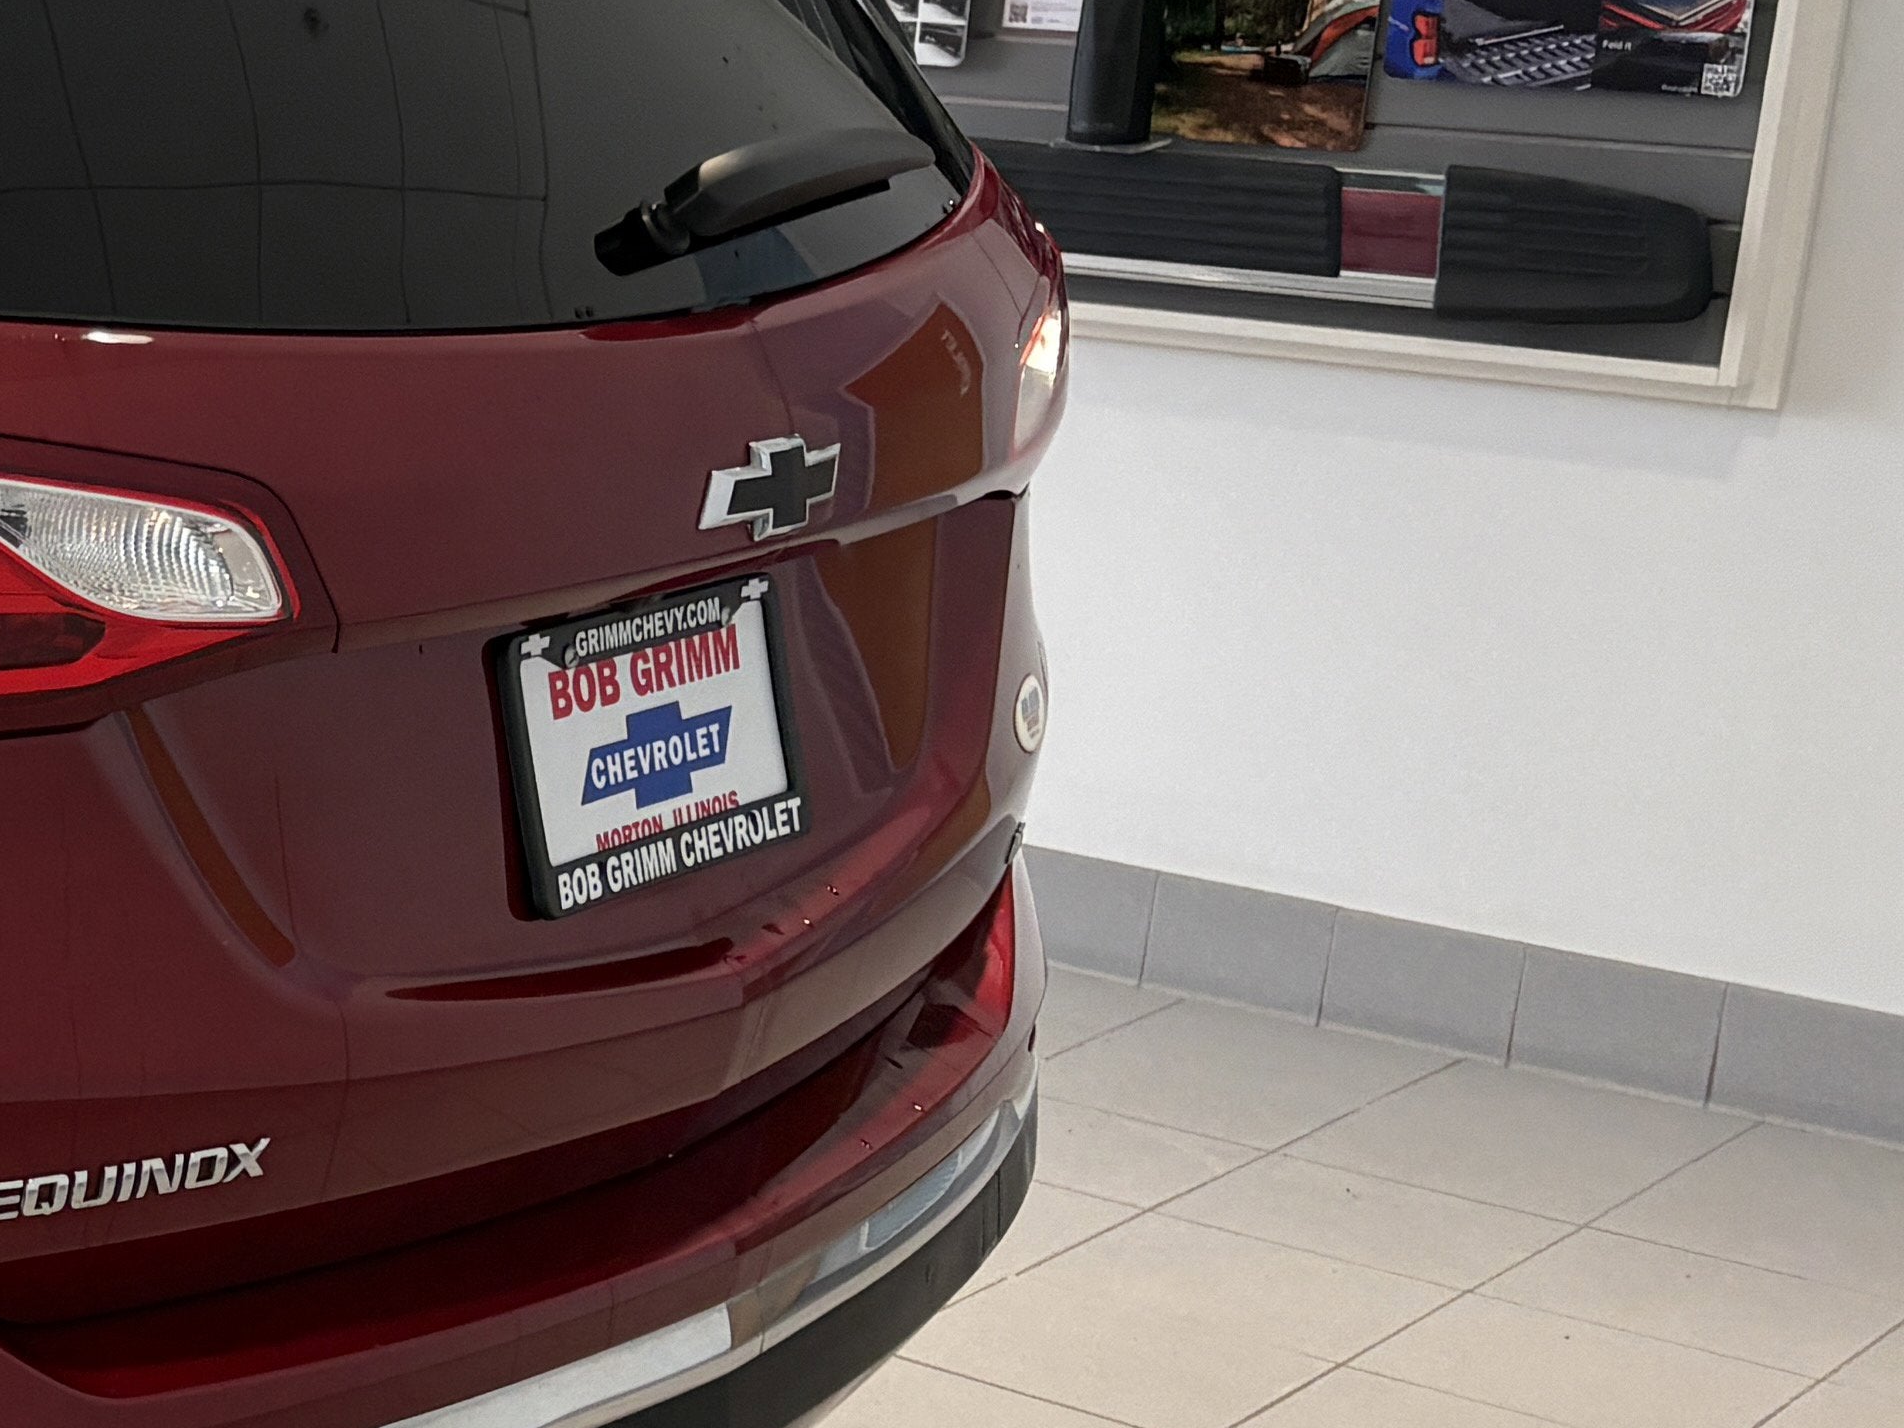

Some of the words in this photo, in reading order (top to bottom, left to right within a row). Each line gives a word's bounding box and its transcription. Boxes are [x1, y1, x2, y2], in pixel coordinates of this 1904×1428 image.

[575, 596, 721, 658] GRIMMCHEVY.COM
[548, 657, 621, 720] BOB
[630, 623, 740, 697] GRIMM
[591, 723, 721, 790] CHEVROLET
[673, 790, 740, 827] ILLINOIS
[558, 863, 604, 910] BOB
[606, 838, 677, 894] GRIMM
[680, 797, 802, 867] CHEVROLET
